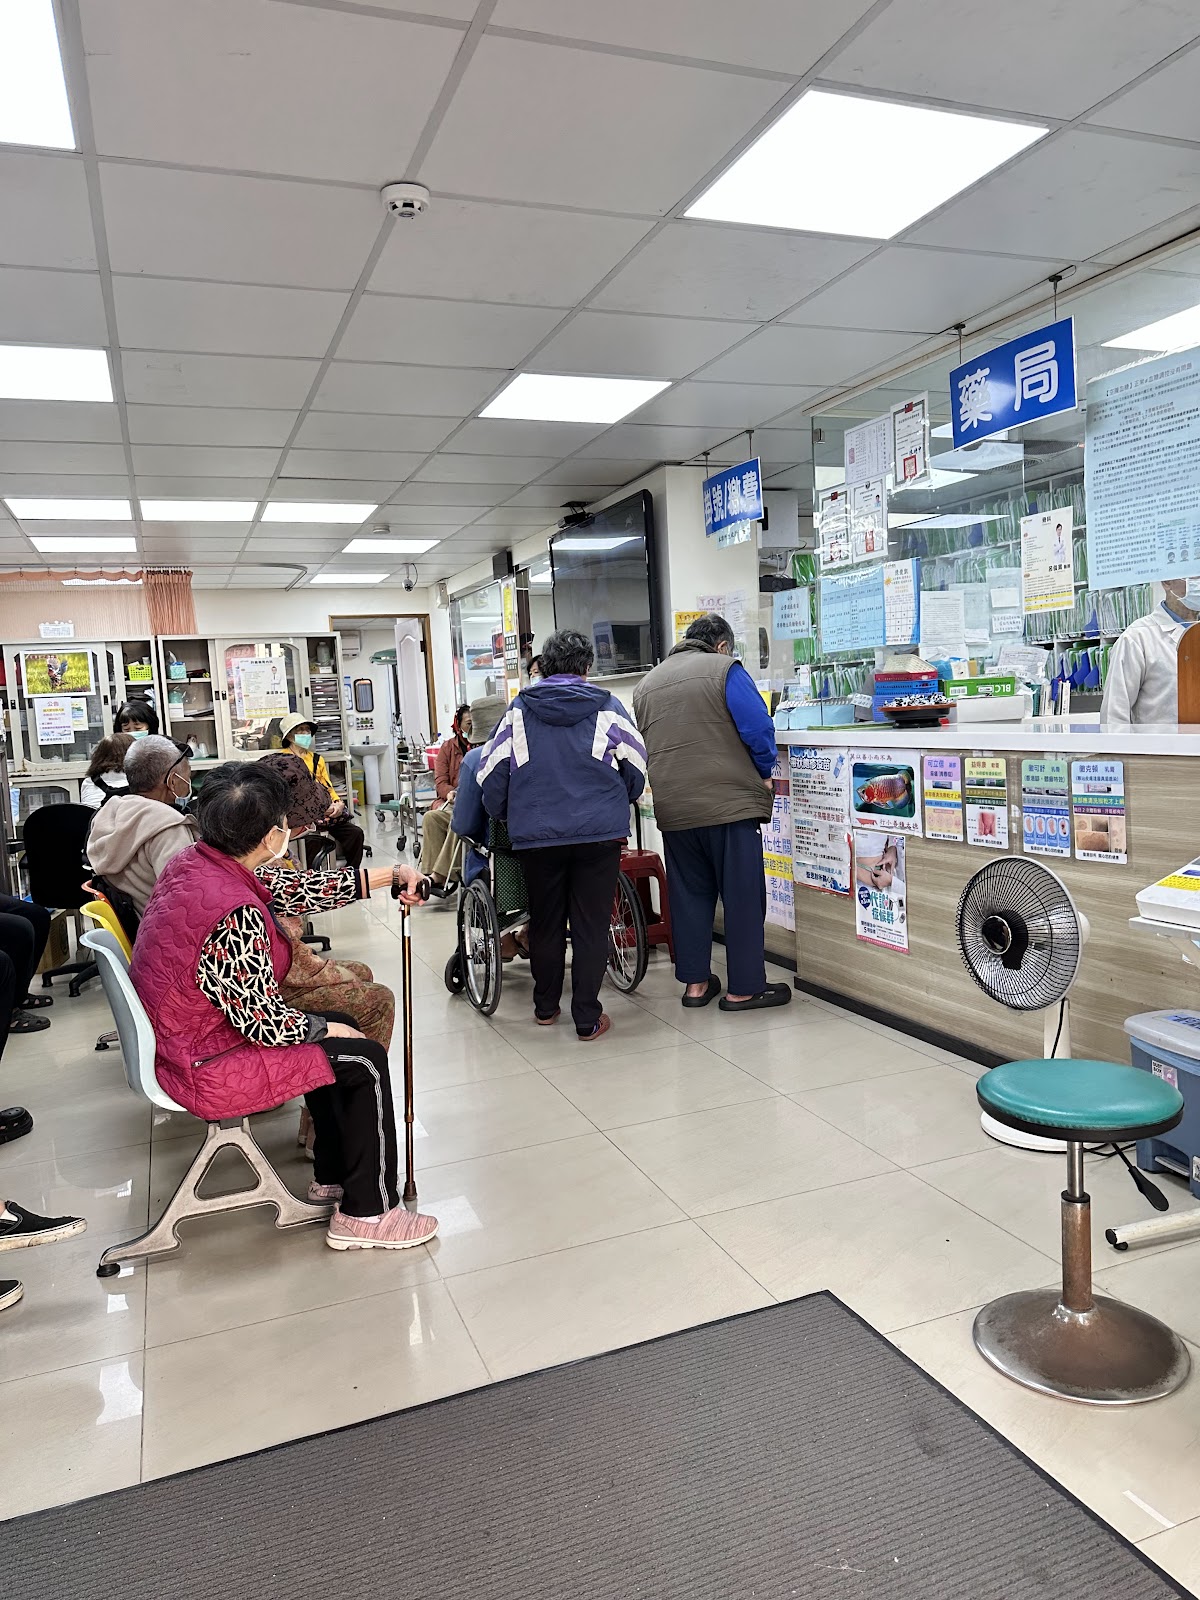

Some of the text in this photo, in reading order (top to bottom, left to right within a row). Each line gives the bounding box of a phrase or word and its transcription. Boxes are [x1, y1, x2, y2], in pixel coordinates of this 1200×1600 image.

[958, 340, 1058, 432] 藥局
[872, 907, 894, 925] 症候群
